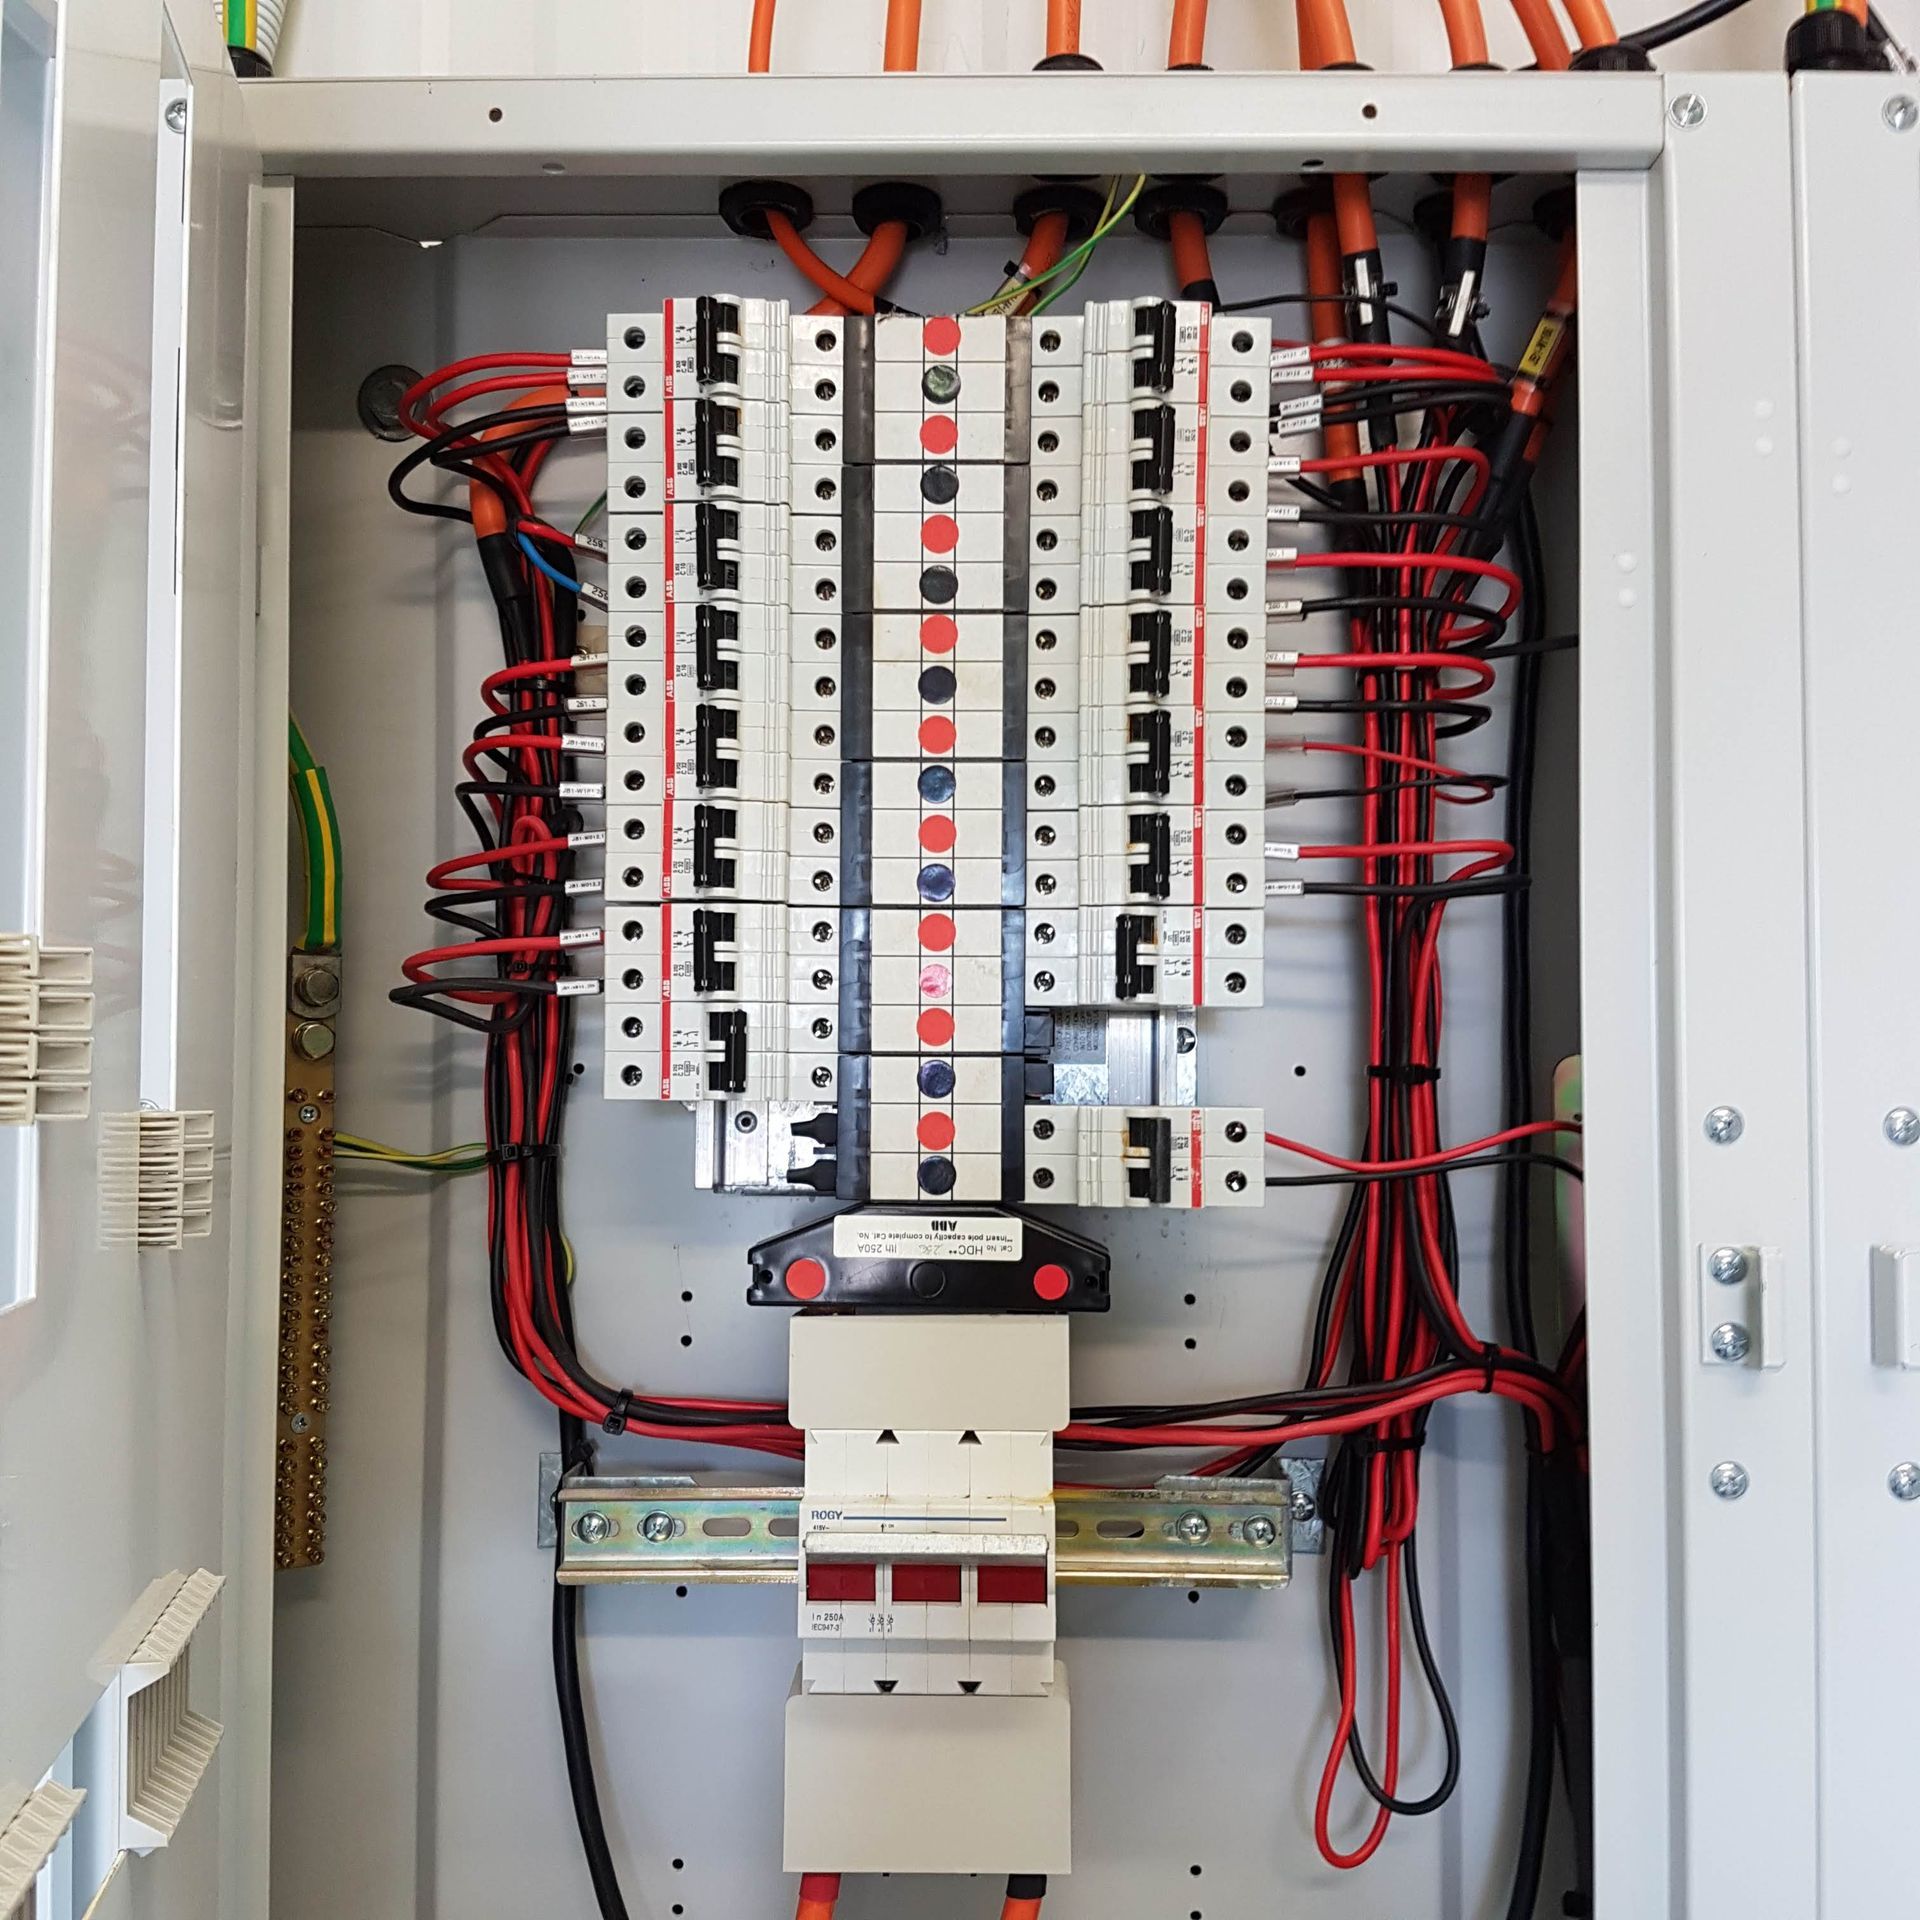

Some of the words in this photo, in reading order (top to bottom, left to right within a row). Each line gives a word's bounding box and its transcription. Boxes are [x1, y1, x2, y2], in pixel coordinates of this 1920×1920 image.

[1201, 306, 1209, 325] ABB
[1197, 508, 1205, 527] ABB
[1195, 609, 1203, 628] ABB
[666, 680, 674, 698] ABB
[1195, 709, 1203, 728] ABB
[666, 778, 674, 796] ABB
[663, 876, 671, 894] ABB
[1194, 910, 1202, 929] ABB
[662, 979, 670, 997] ABB
[662, 1078, 670, 1097] ABB
[931, 1220, 958, 1231] ABB
[888, 1232, 923, 1241] complete
[935, 1233, 967, 1242] capacity
[968, 1234, 984, 1242] pole
[857, 1243, 882, 1253] 250A
[811, 1510, 843, 1520] ROGY
[824, 1612, 844, 1621] 250A
